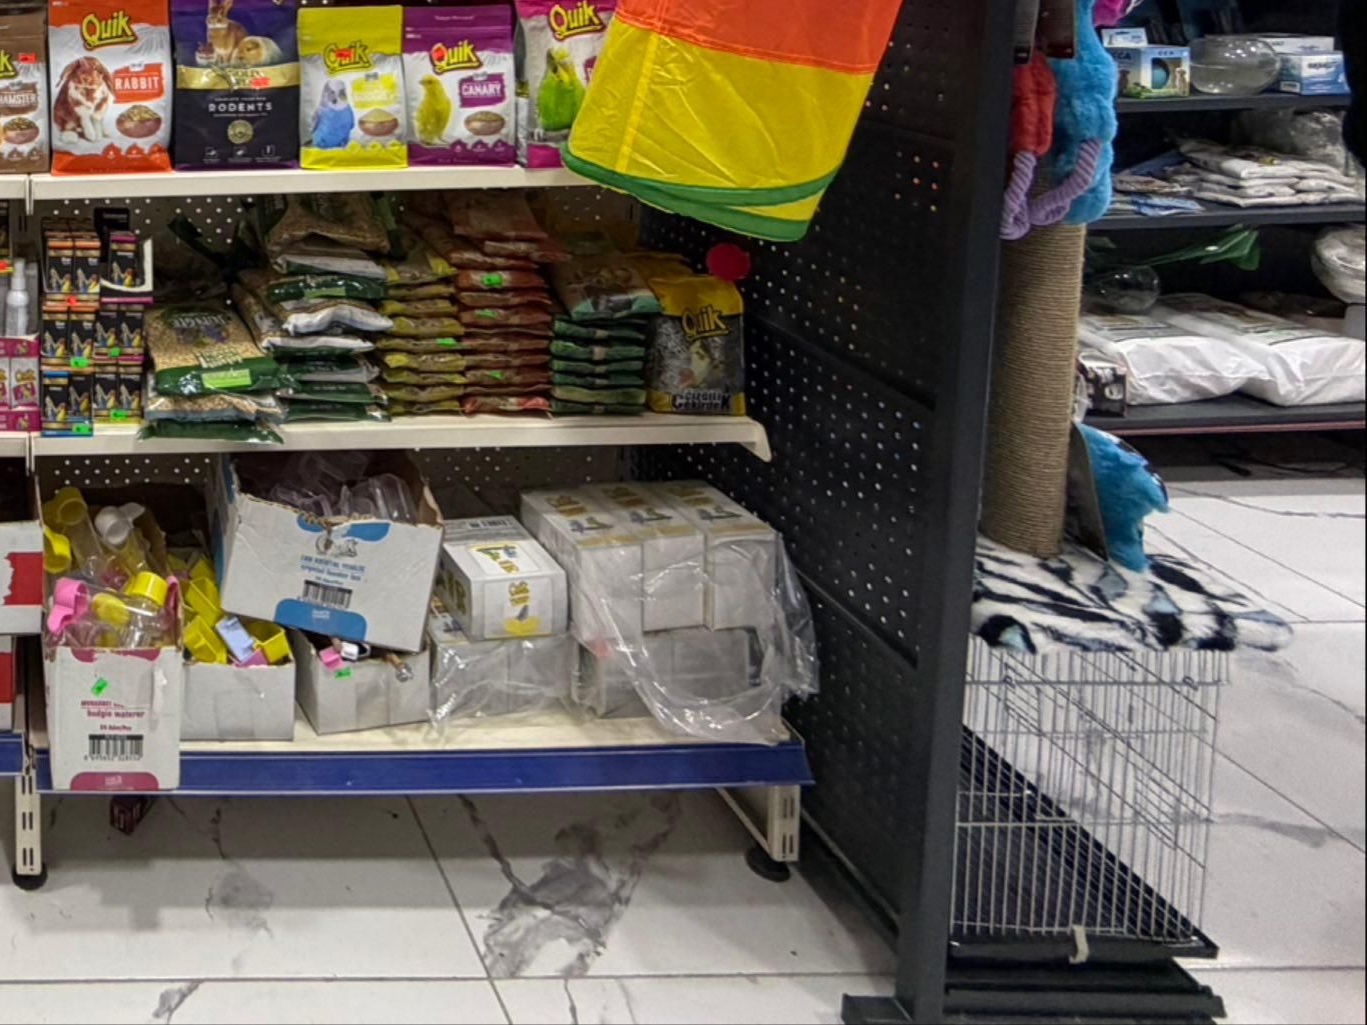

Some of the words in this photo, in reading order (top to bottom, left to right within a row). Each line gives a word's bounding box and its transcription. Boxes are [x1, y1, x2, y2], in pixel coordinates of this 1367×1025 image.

[82, 11, 137, 50] Quik
[549, 0, 603, 41] Quik
[430, 40, 483, 74] Quik
[115, 75, 160, 91] RABBIT
[461, 83, 502, 96] CANARY
[208, 102, 273, 112] RODENTS
